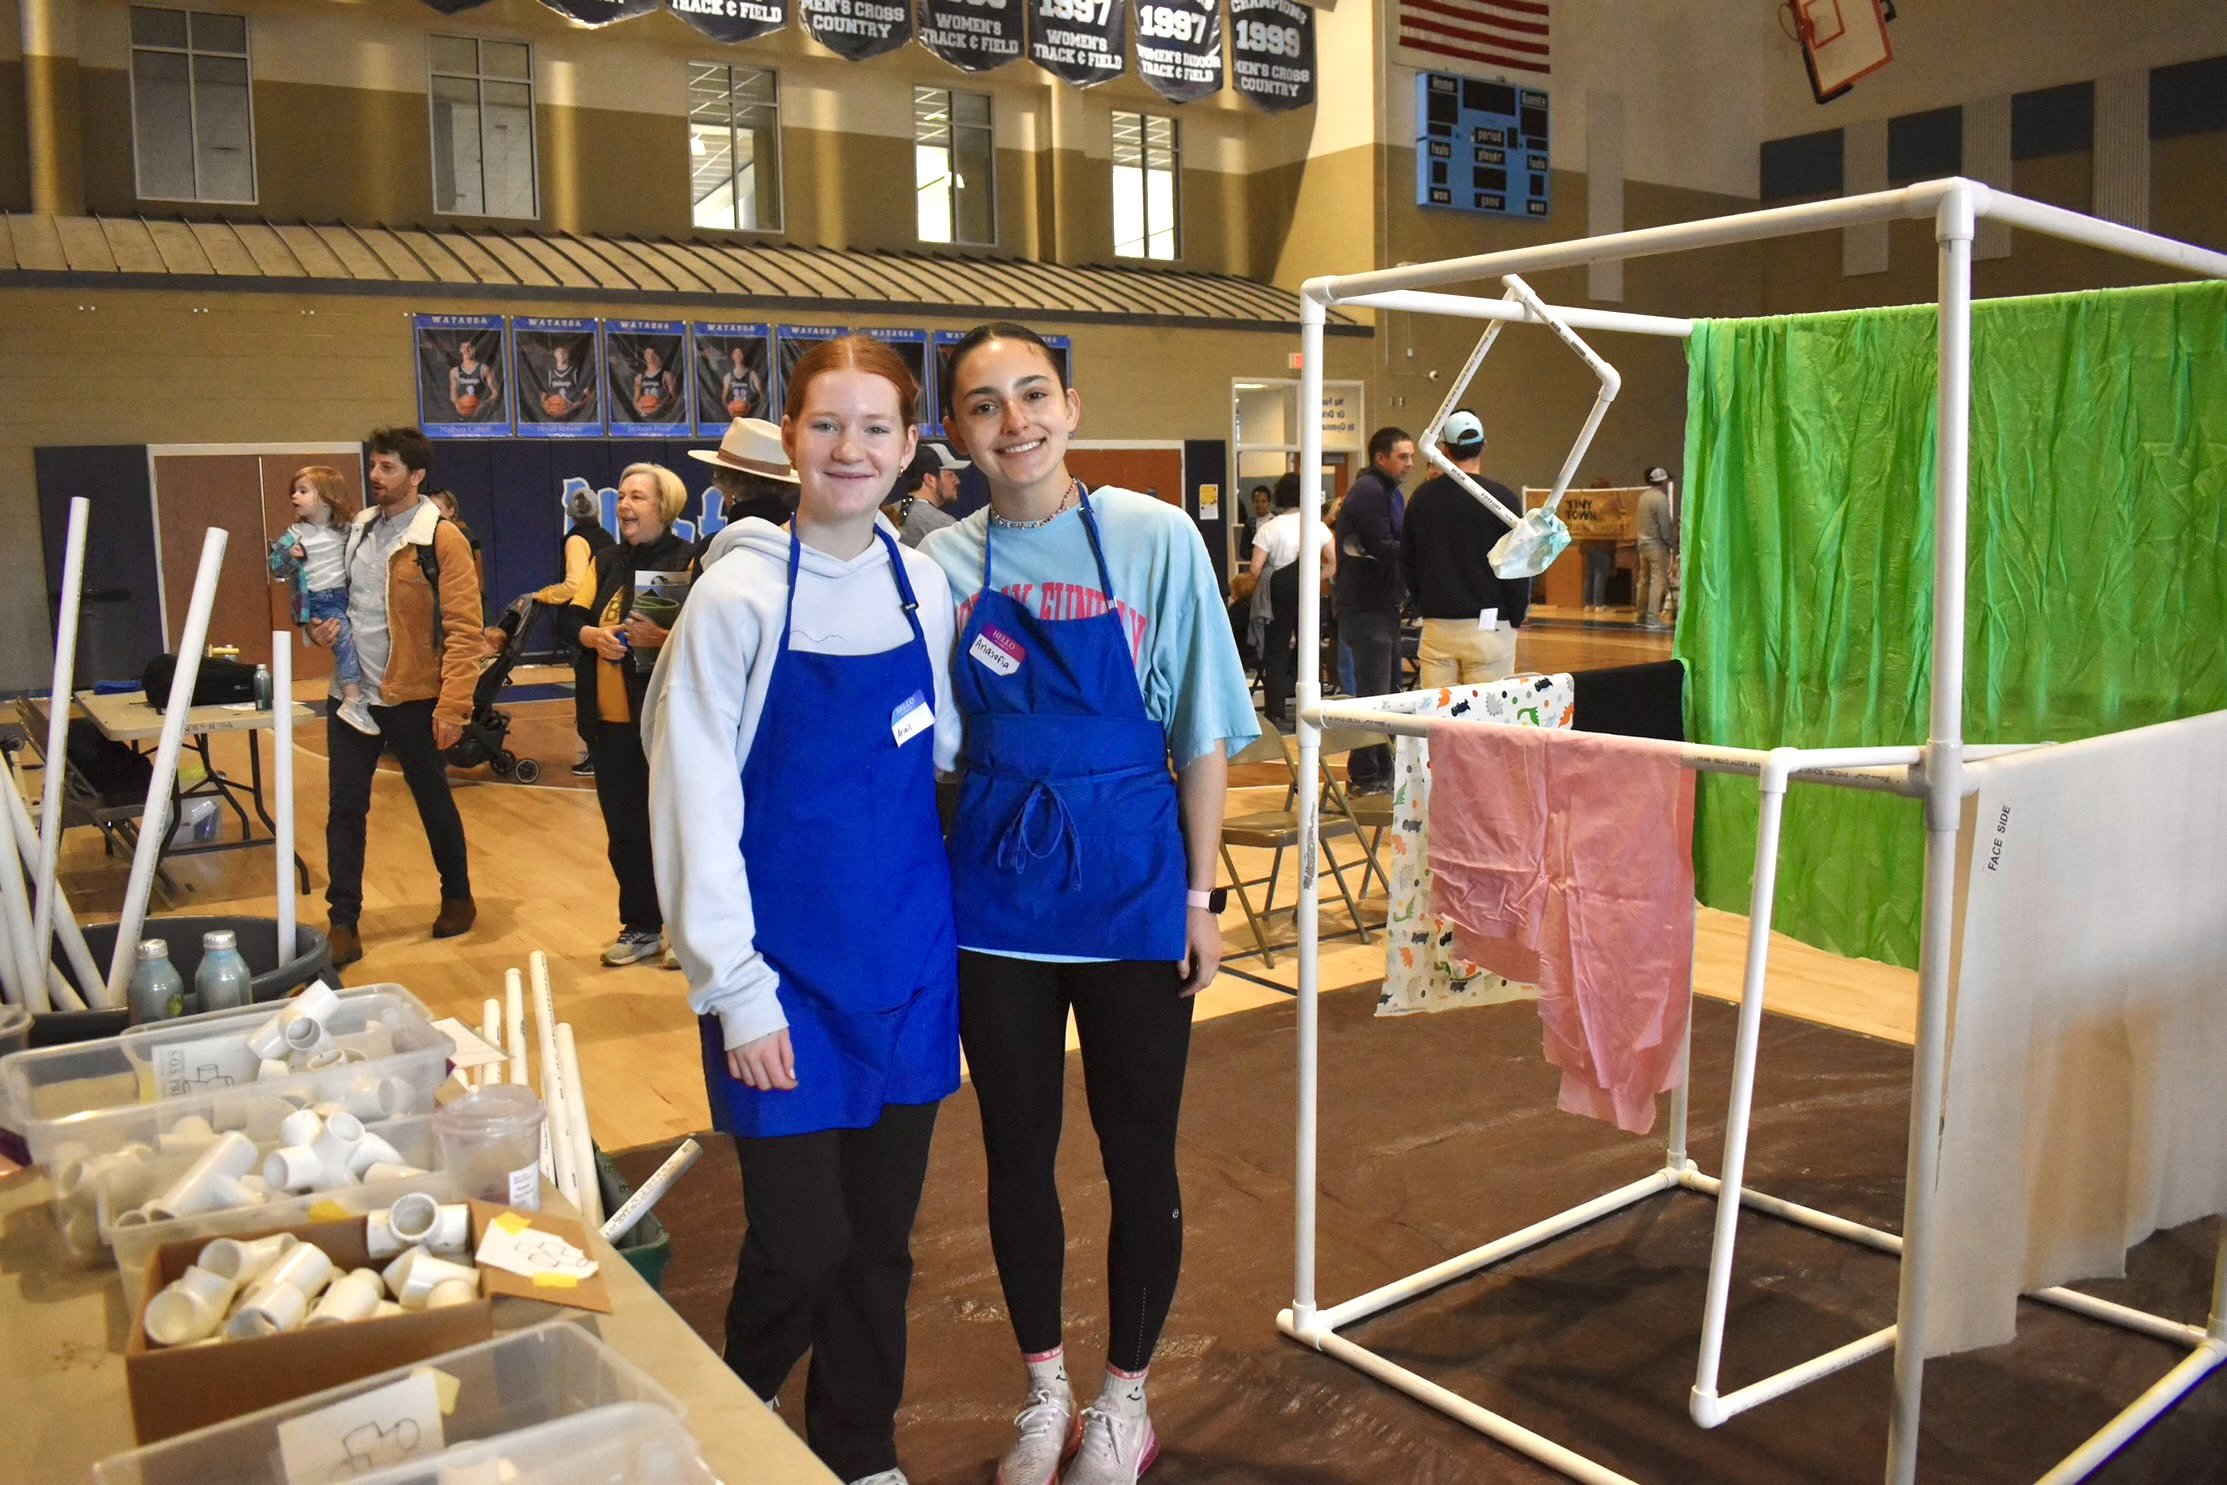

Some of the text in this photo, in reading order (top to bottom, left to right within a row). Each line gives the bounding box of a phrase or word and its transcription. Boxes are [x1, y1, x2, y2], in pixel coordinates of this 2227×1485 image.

[672, 0, 724, 15] TRACK
[740, 2, 782, 22] FIELD
[854, 1, 905, 22] CROSS
[813, 14, 892, 38] COUNTRY
[935, 12, 1001, 36] WOMEN'S
[1140, 5, 1206, 44] 1997
[921, 27, 967, 48] TRACK
[981, 35, 1018, 54] FIELD
[1046, 29, 1107, 52] WOMEN'S
[1236, 20, 1300, 58] 1999
[1033, 43, 1075, 63] TRACK
[1088, 52, 1122, 70] FIELD
[1141, 60, 1175, 78] TRACK
[1184, 68, 1214, 82] FIELD
[1234, 60, 1310, 82] MEN'S CROSS
[1241, 76, 1299, 97] COUNTRY
[431, 316, 488, 325] WATAUGA
[1565, 510, 1598, 521] TOWN
[1566, 500, 1592, 510] TINY
[993, 631, 1015, 650] HELLO
[975, 638, 1010, 669] Anasofia
[1987, 804, 2011, 872] FACE SIDE
